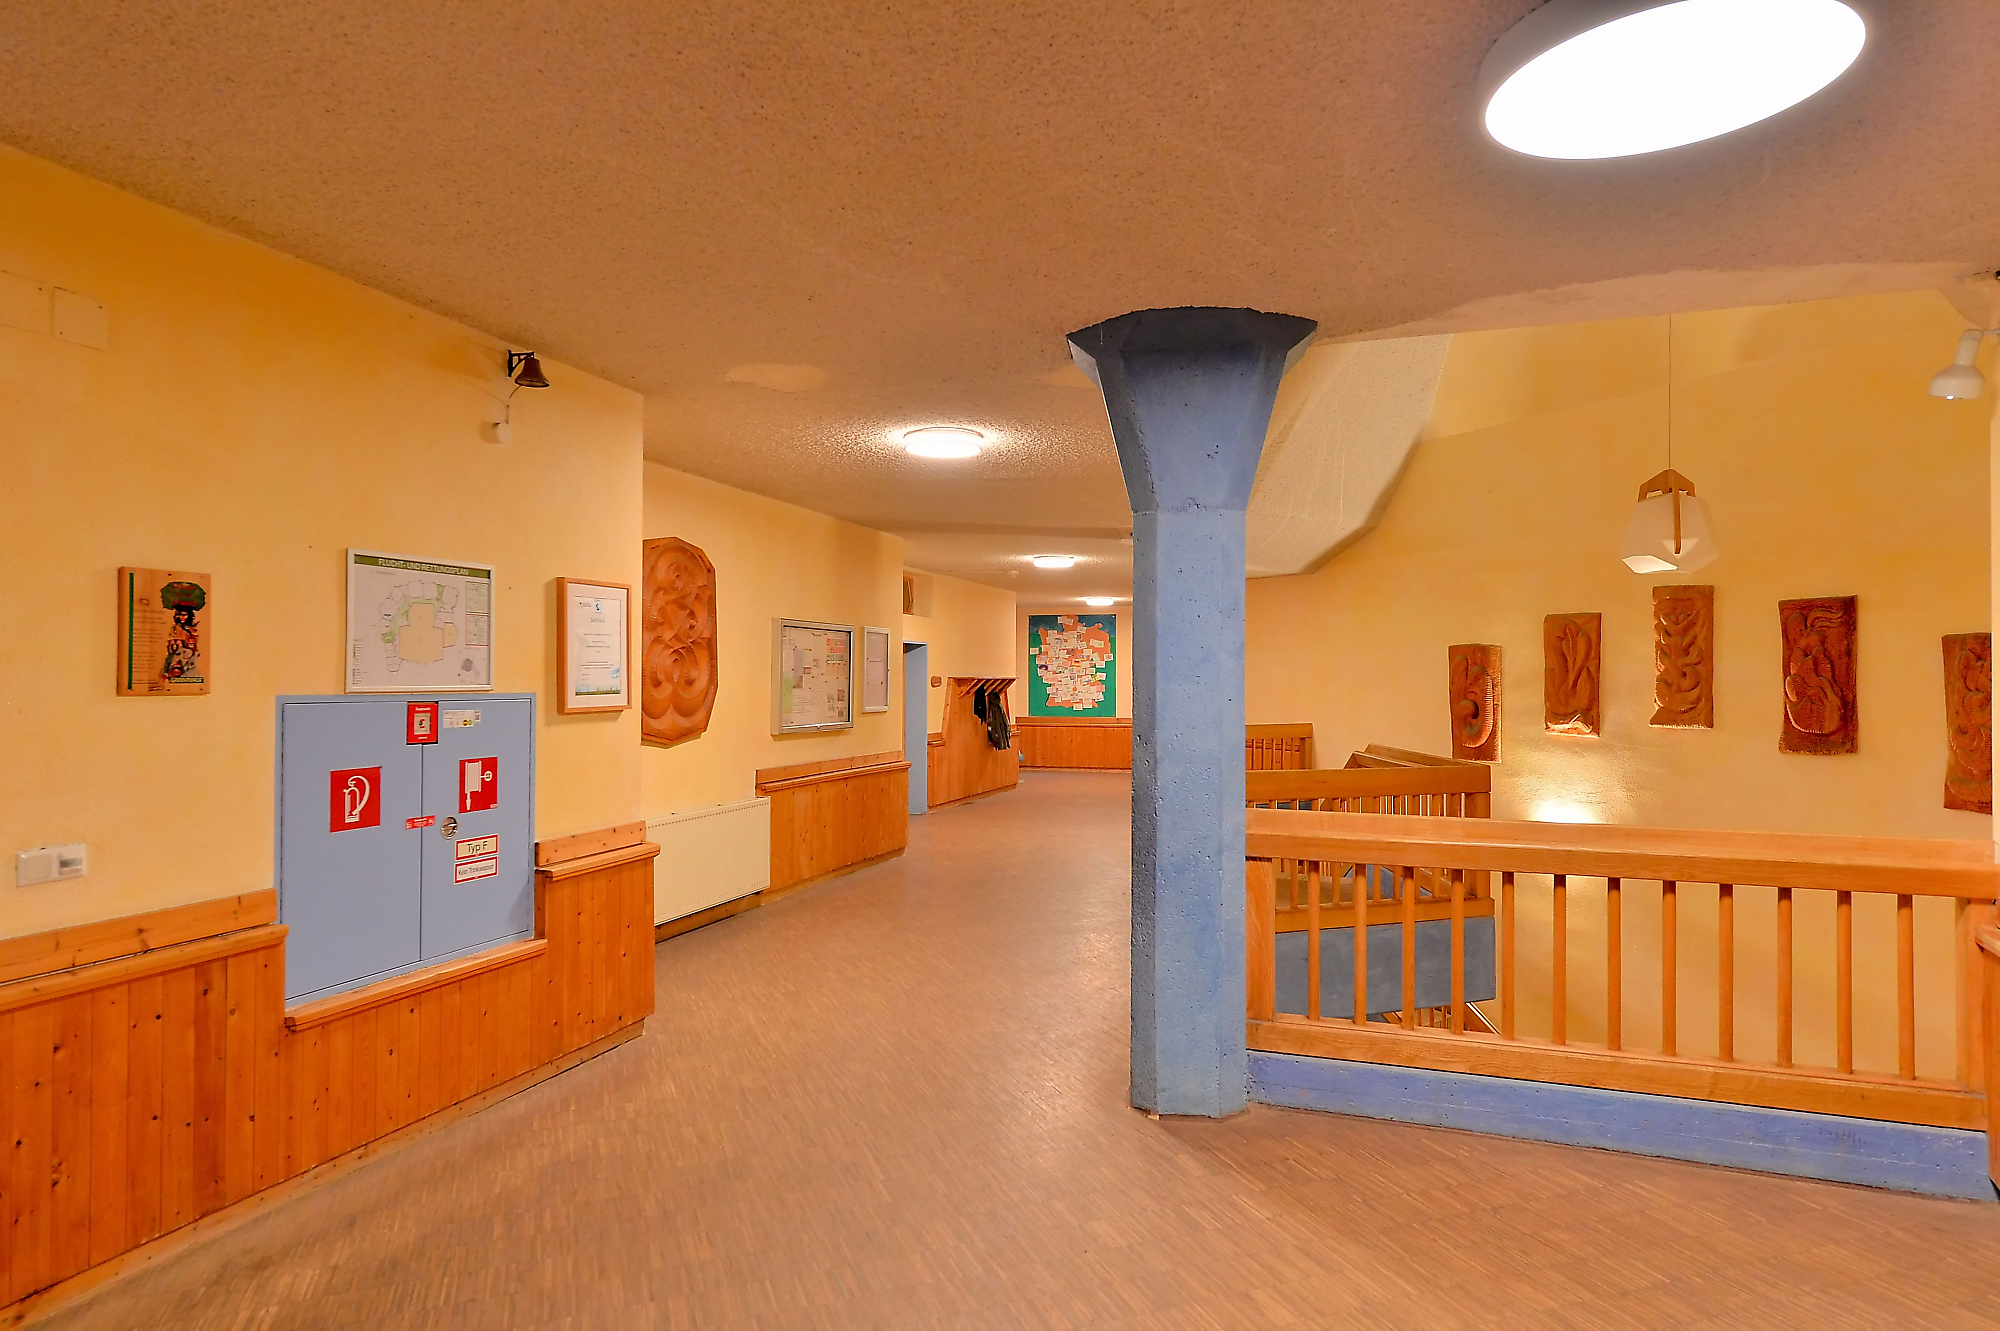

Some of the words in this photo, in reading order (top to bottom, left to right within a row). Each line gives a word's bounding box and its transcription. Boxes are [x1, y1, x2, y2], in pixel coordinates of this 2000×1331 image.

[378, 558, 406, 568] FLUCHT-
[406, 562, 420, 570] UND
[421, 564, 469, 575] RETTUNGSPLAN
[467, 843, 480, 854] Typ
[482, 841, 488, 850] F
